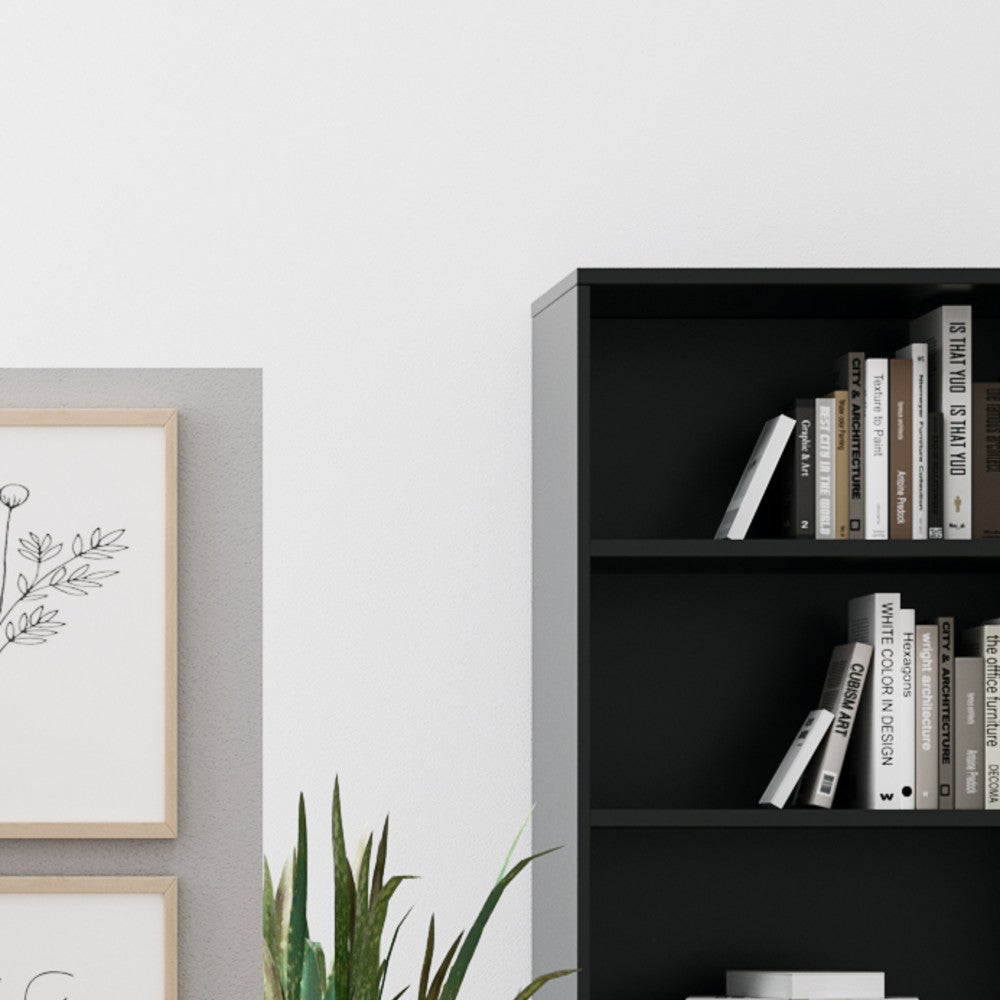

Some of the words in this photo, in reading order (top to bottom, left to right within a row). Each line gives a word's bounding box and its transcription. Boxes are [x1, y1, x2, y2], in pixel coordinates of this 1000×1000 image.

[949, 322, 966, 334] IS
[949, 338, 966, 365] THAT
[852, 358, 861, 387] CITY
[852, 390, 861, 399] &
[873, 374, 884, 413] Texture
[873, 416, 884, 426] to
[949, 404, 966, 417] IS
[799, 419, 812, 452] Graphic
[873, 430, 884, 457] Paint
[949, 420, 966, 449] THAT
[852, 403, 861, 500] ARCHITECTURE
[799, 462, 812, 477] Art
[820, 476, 831, 496] THE
[801, 520, 809, 529] 2
[881, 602, 894, 645] WHITE
[942, 621, 950, 652] CITY
[901, 632, 914, 698] Hexagons
[920, 632, 933, 673] wright
[942, 654, 950, 663] &
[881, 648, 894, 695] COLOR
[842, 663, 864, 710] CUBISM
[881, 699, 894, 712] IN
[920, 675, 933, 752] architecture
[942, 668, 950, 764] ARCHITECTURE
[835, 711, 849, 738] ART
[881, 716, 894, 766] DESIGN
[989, 764, 999, 803] DECOMA
